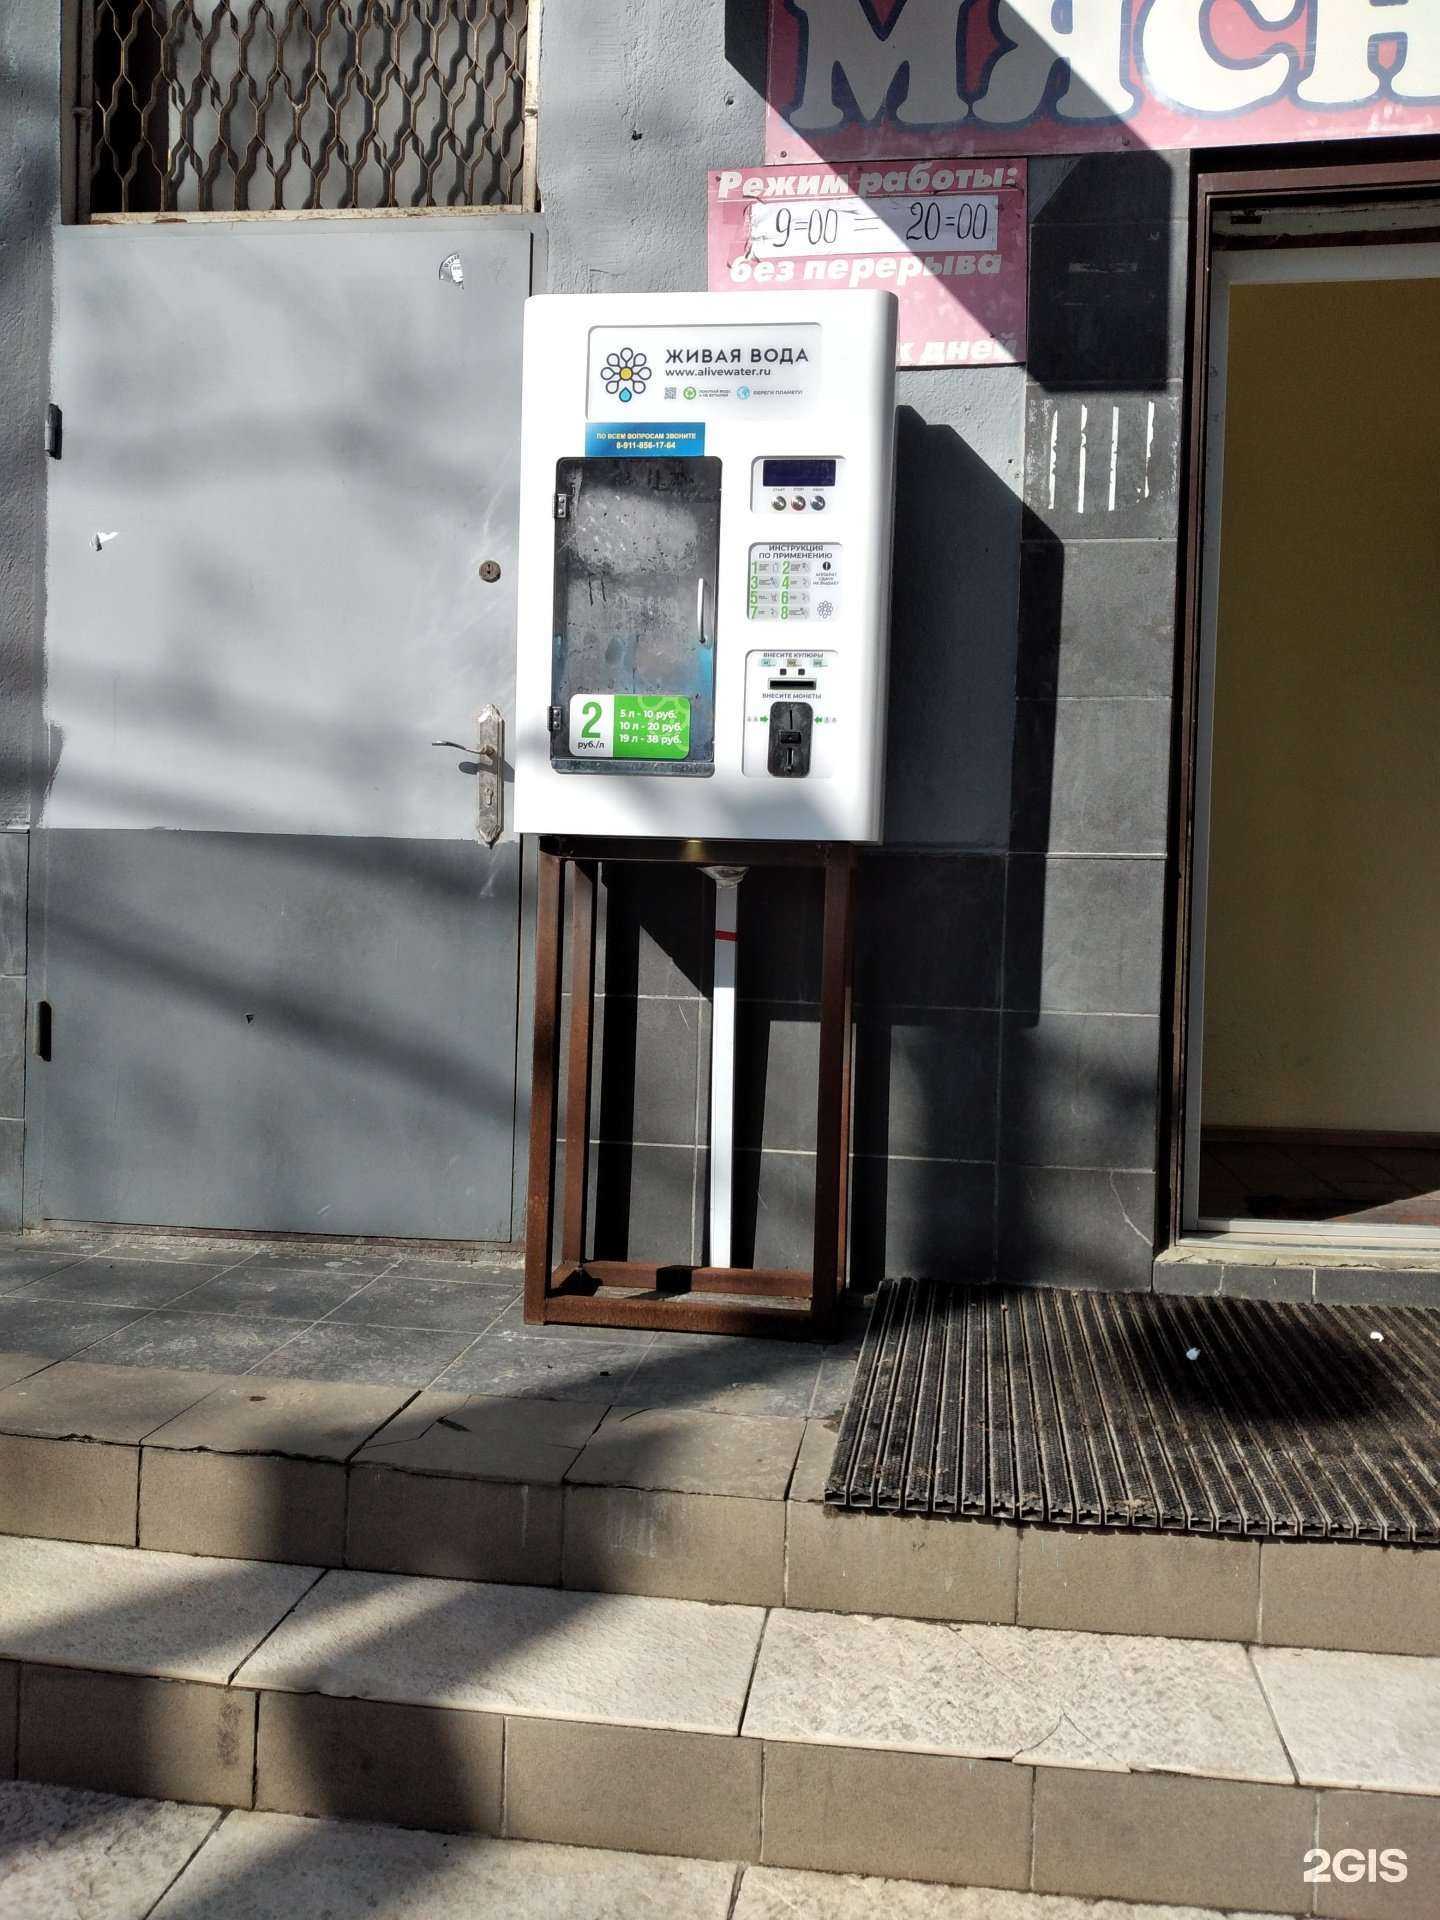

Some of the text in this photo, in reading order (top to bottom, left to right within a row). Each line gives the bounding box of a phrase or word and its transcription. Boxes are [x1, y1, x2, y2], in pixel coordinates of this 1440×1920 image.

[717, 162, 1017, 199] Режим работы:
[906, 201, 988, 241] 20=00
[730, 254, 1003, 288] без перерыва
[918, 332, 1018, 365] дней
[665, 347, 809, 365] ЖИВАЯ ВОДА
[665, 366, 771, 377] www.alivewater.ru
[768, 544, 824, 552] ИНСТРУКЦИЯ
[751, 561, 758, 574] 1
[782, 561, 790, 574] 2
[750, 576, 759, 590] 3
[781, 576, 790, 590] 4
[750, 591, 758, 605] 5
[781, 591, 789, 605] 6
[750, 606, 759, 619] 7
[780, 606, 789, 620] 8
[581, 701, 603, 739] 2
[619, 709, 626, 718] 5
[643, 709, 654, 718] 10
[656, 709, 677, 721] руб.
[619, 721, 631, 730] 10
[647, 721, 660, 731] 20
[577, 740, 605, 750] руб./л
[619, 734, 629, 743] 19
[631, 735, 639, 743] л
[646, 734, 659, 743] 38
[661, 734, 682, 746] руб.
